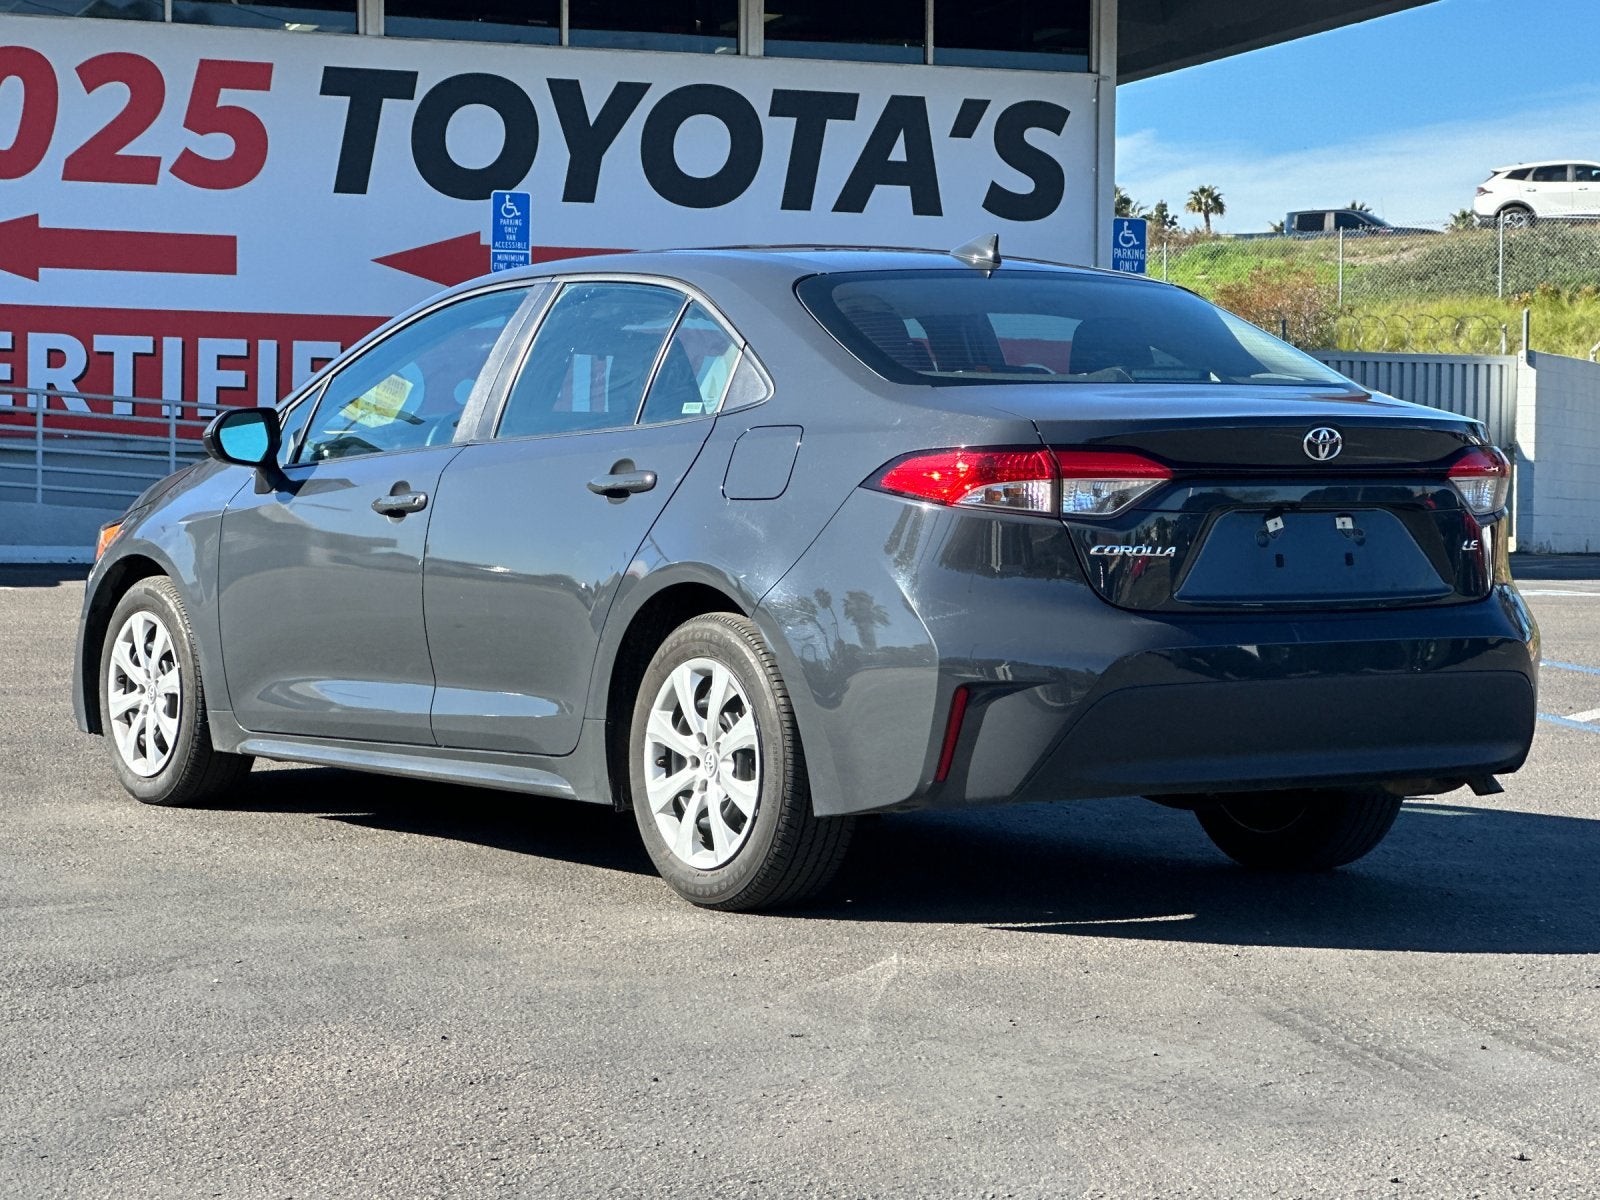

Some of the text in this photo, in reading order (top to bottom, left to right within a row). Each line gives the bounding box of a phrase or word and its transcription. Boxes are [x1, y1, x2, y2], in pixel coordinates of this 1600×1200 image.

[0, 46, 1071, 222] 025 TOYOTA'S
[500, 218, 522, 226] PARKING
[504, 226, 518, 234] ONLY
[495, 241, 527, 249] ACCESSIBLE
[497, 254, 525, 262] MINIMUM
[1113, 247, 1145, 260] PARKING
[493, 262, 507, 270] FINE
[1119, 260, 1139, 272] ONLY
[0, 332, 342, 417] RTIFI
[1089, 544, 1177, 557] COROLLA
[1461, 540, 1479, 551] LE
